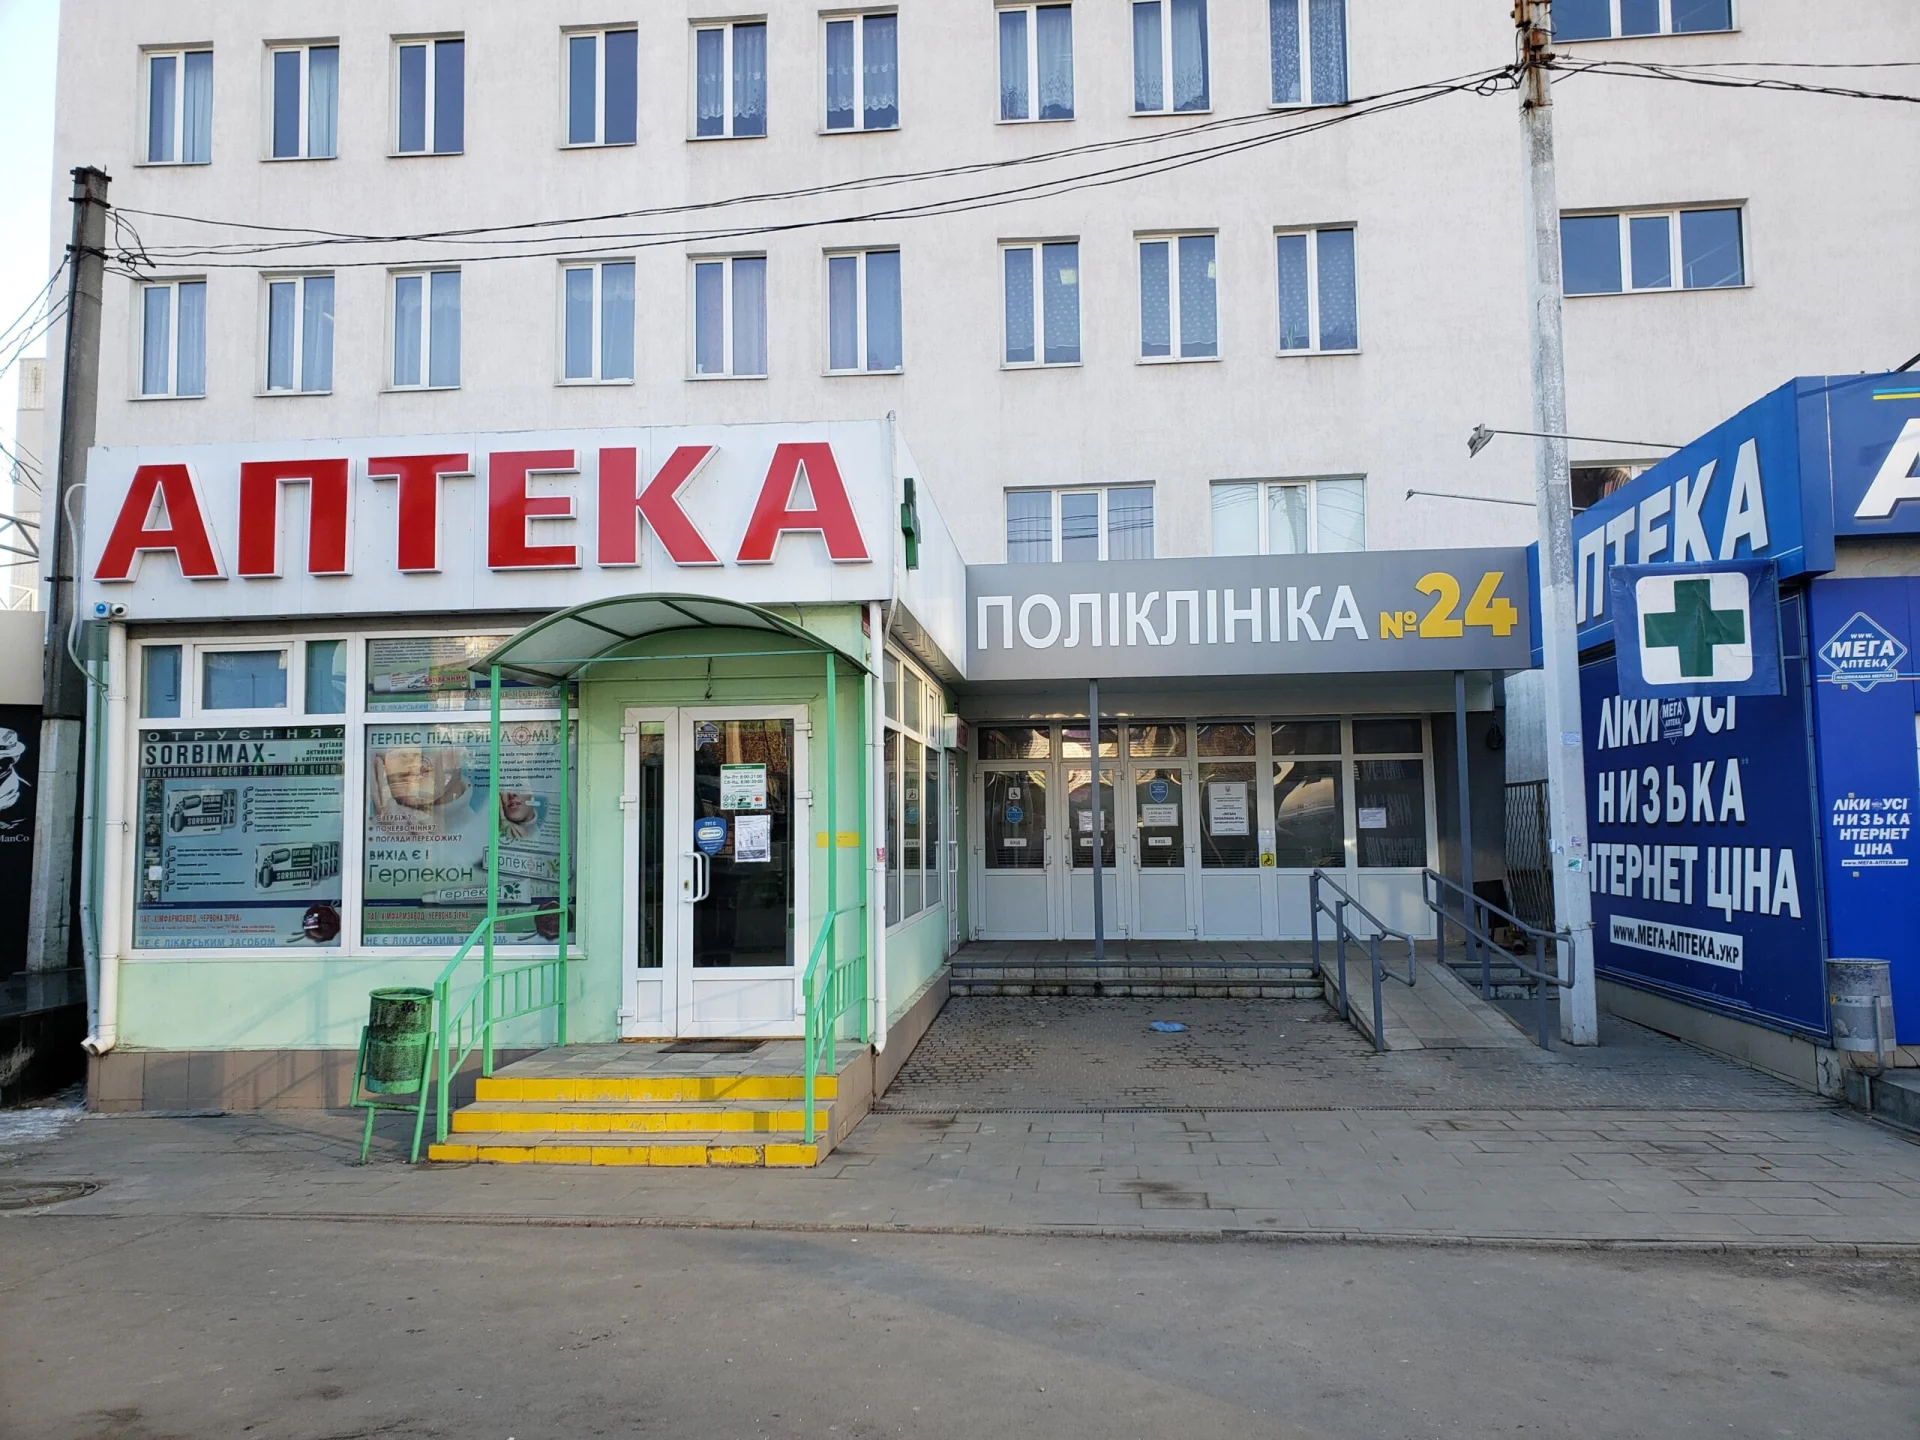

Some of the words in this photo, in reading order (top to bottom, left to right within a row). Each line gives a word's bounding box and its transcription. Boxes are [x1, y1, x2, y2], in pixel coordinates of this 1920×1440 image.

[93, 441, 873, 583] АПТЕКА
[1577, 437, 1769, 625] ПТЕКА
[977, 585, 1369, 650] ПОЛІКЛІНІКА
[1831, 640, 1895, 658] МЕГА
[1840, 659, 1889, 669] АПТЕКА
[1662, 701, 1683, 719] МЕГА
[1597, 695, 1659, 750] ЛІКИ
[1683, 696, 1736, 737] УСІ
[147, 728, 344, 743] ОТРУЄННЯ?
[371, 732, 422, 745] ГЕРПЕС
[427, 732, 452, 745] ПІД
[144, 767, 212, 779] МАКСИМАЛЬНИЙ
[217, 766, 243, 777] ЕФЕКТ
[248, 766, 258, 776] ЗА
[262, 764, 305, 777] ВИГІДНОЮ
[1598, 757, 1746, 824] НИЗЬКА
[1833, 798, 1871, 811] ЛІКИ
[1882, 798, 1908, 810] УСІ
[186, 815, 221, 827] SORBIMAX
[1833, 813, 1911, 826] НИЗЬКА
[412, 834, 463, 842] ПЕРЕХОЖИХ?
[1840, 828, 1910, 840] НТЕРНЕТ
[369, 850, 408, 861] ВИХІД
[1854, 843, 1893, 857] ЦІНА
[276, 870, 310, 880] SORBIMAX
[368, 864, 474, 887] Герпекон
[1707, 846, 1801, 922] ЦІНА
[139, 939, 149, 948] НЕ
[154, 939, 160, 947] Є
[164, 938, 225, 947] ЛІКАРСЬКИМ
[229, 937, 276, 947] ЗАСОБОМ
[366, 937, 379, 945] НЕ
[382, 937, 388, 945] Є
[392, 936, 454, 945] ЛІКАРСЬКИМ
